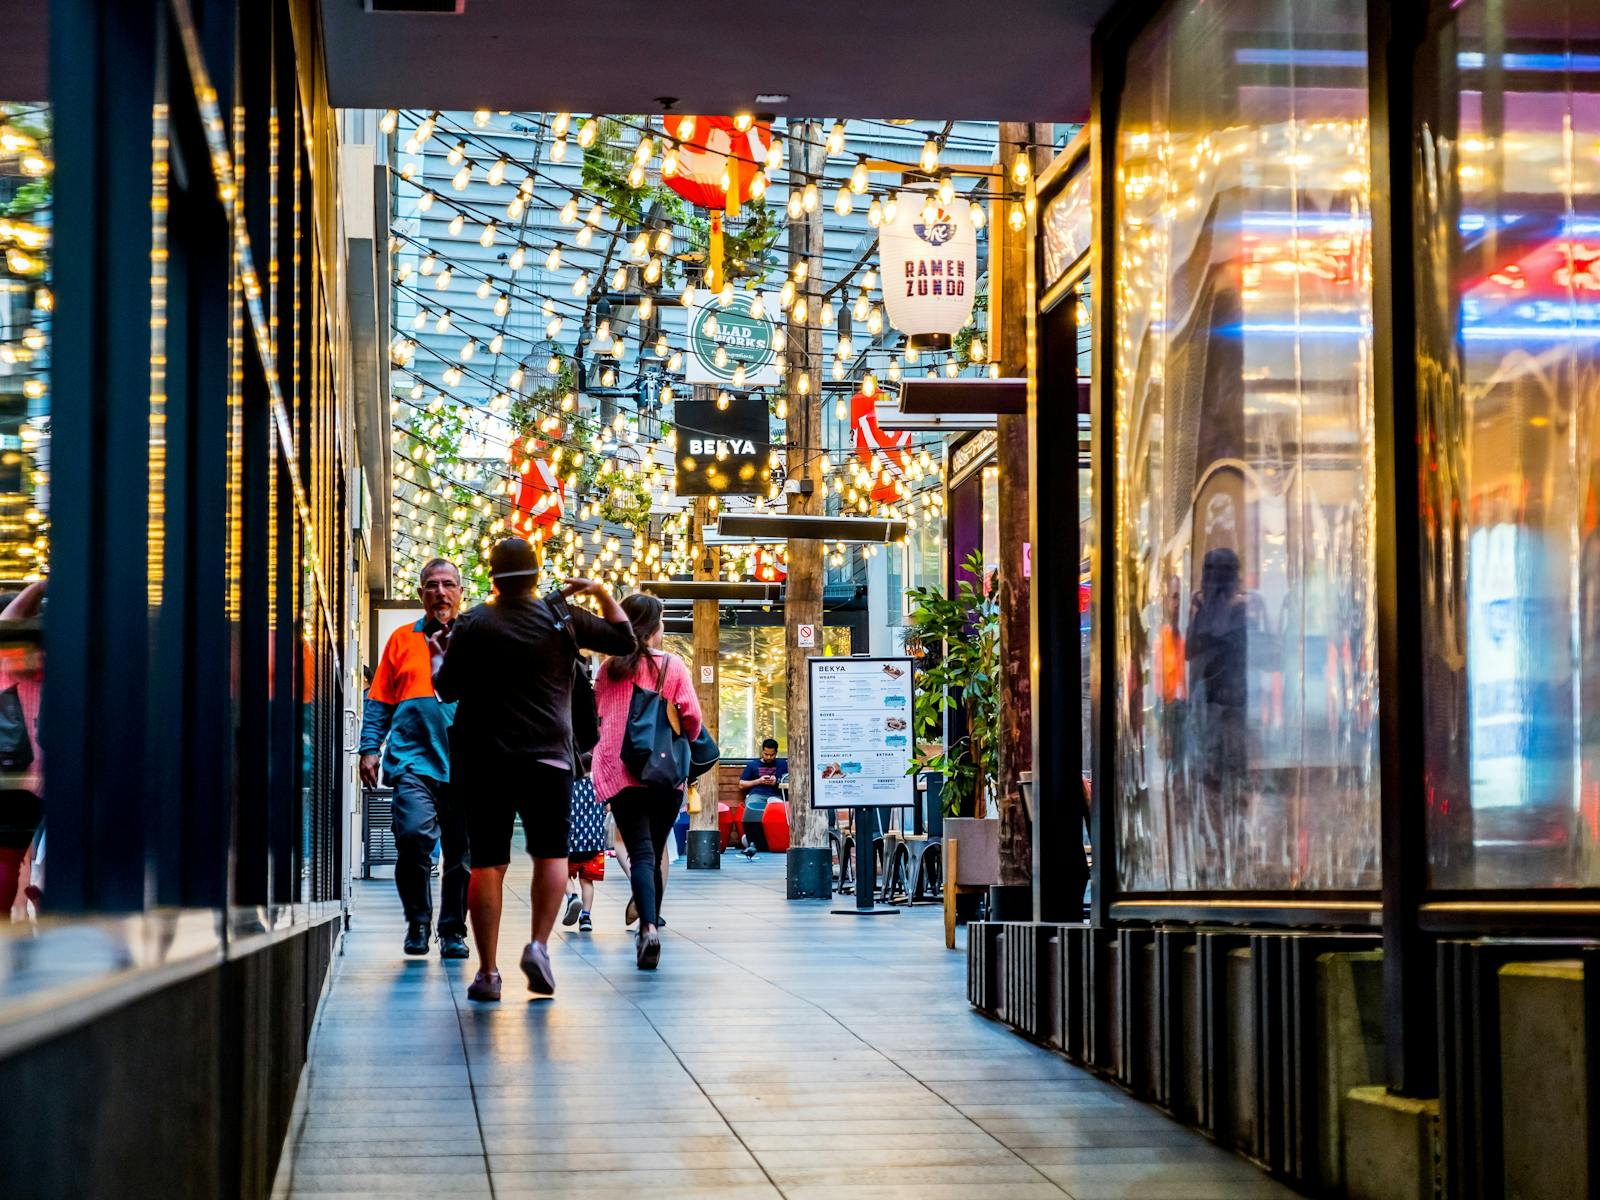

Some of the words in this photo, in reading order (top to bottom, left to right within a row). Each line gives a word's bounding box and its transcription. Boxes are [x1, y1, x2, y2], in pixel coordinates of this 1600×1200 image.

[905, 260, 965, 278] RAMEN
[906, 279, 965, 297] ZUNDO
[702, 324, 752, 338] ALAD
[713, 335, 766, 349] WORKS
